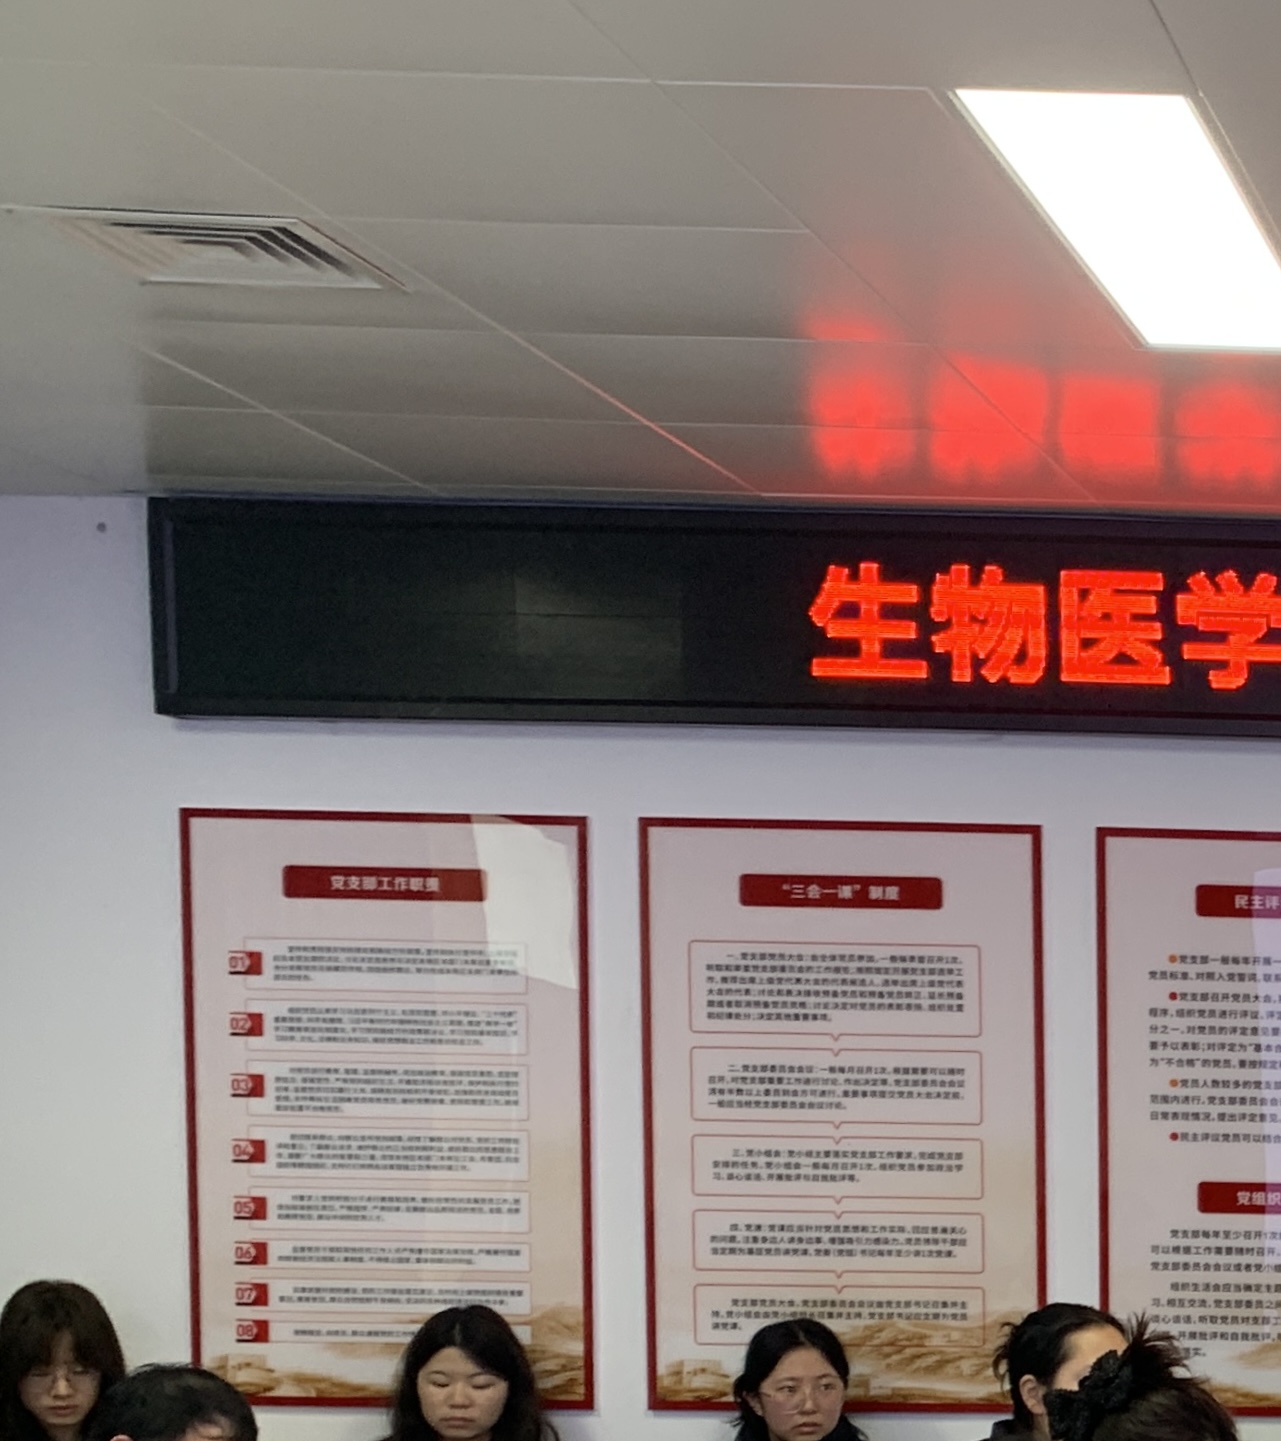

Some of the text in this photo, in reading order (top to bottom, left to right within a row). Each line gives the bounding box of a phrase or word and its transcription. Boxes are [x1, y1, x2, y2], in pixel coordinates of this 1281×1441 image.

[229, 956, 246, 969] 01
[230, 1018, 249, 1031] 02
[231, 1078, 249, 1091] 03
[233, 1144, 250, 1157] 04
[234, 1201, 251, 1213] 05
[235, 1246, 251, 1259] 06
[236, 1287, 252, 1300] 07
[236, 1324, 253, 1337] 08
